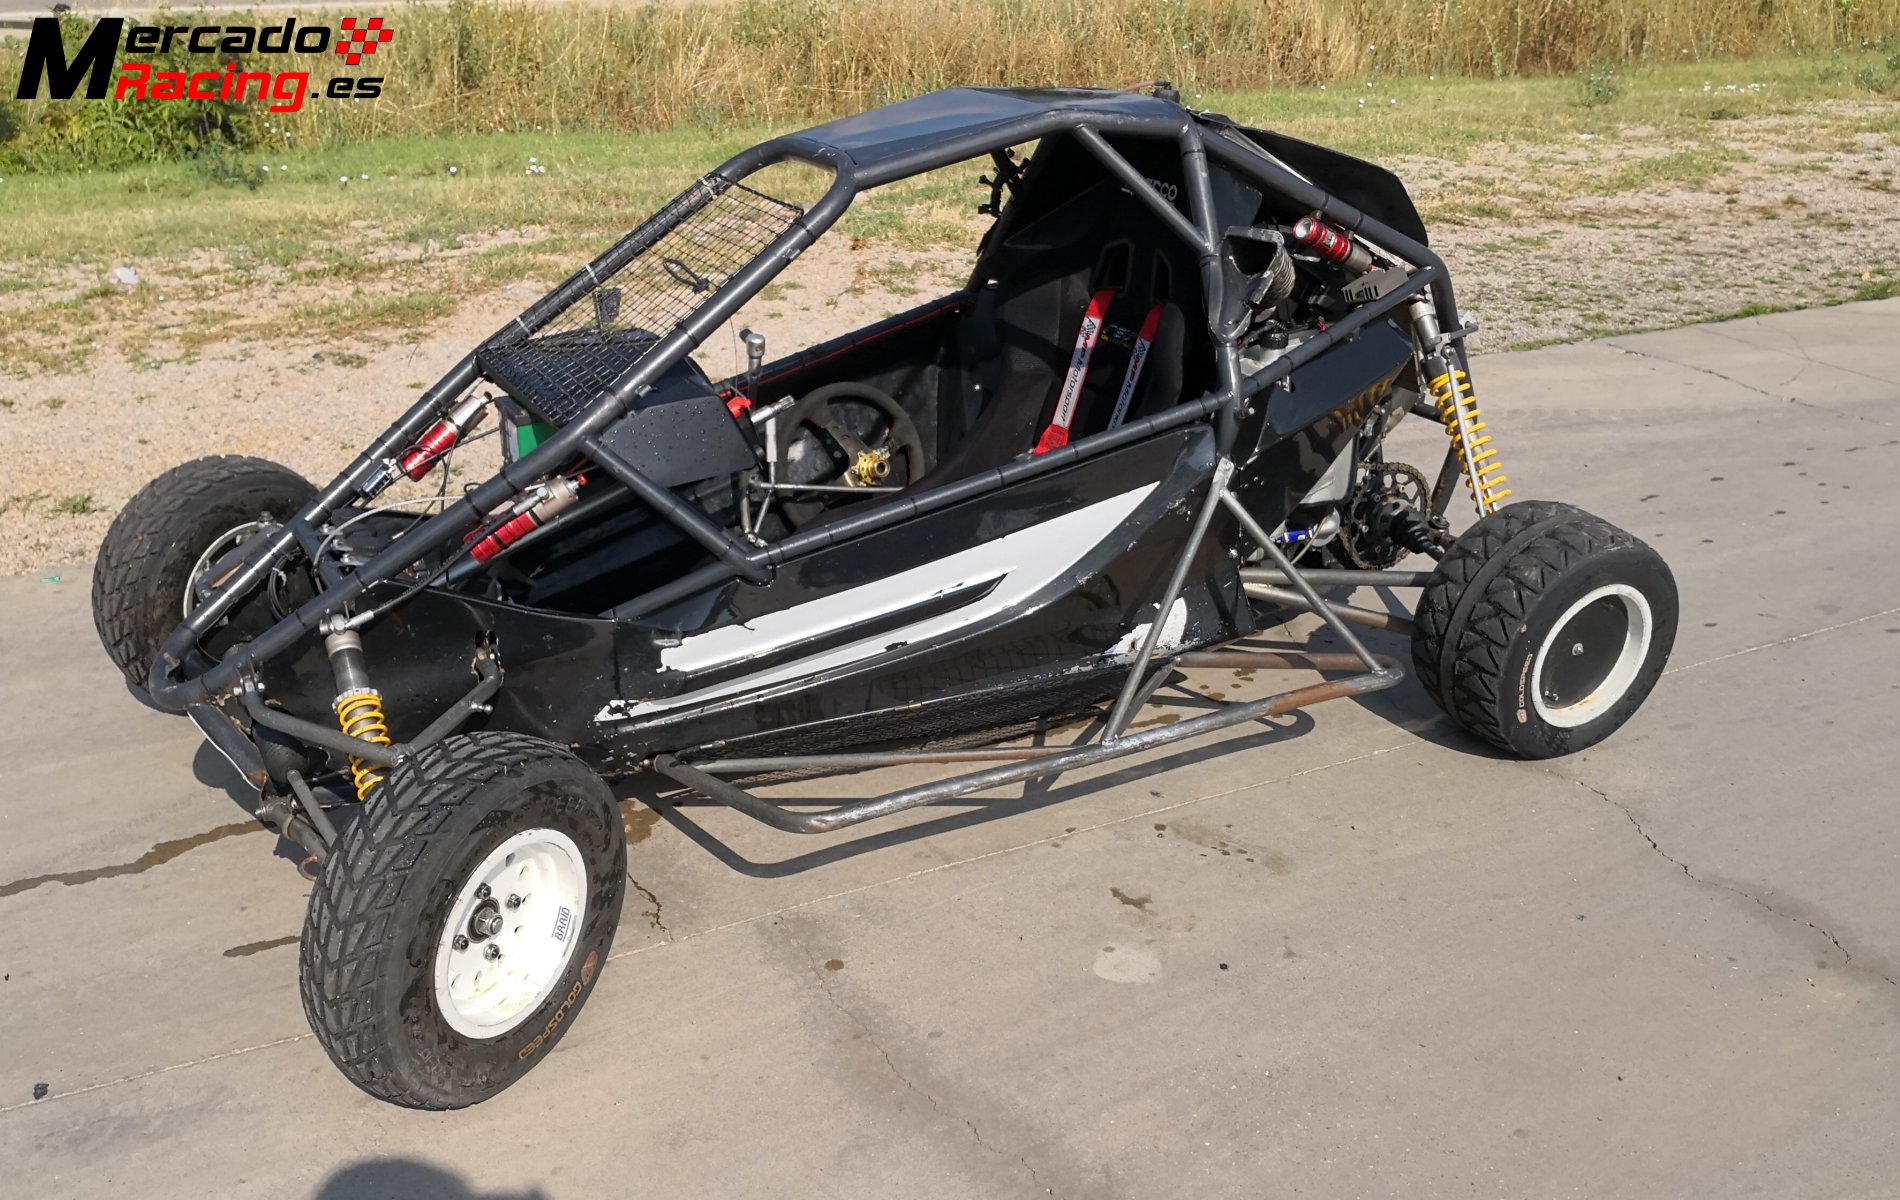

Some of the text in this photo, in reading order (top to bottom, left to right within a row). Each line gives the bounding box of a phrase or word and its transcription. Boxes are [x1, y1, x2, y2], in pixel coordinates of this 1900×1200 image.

[1060, 359, 1083, 422] Motorsport
[554, 907, 570, 941] BRAID
[518, 982, 583, 1060] GOLDSPEED
